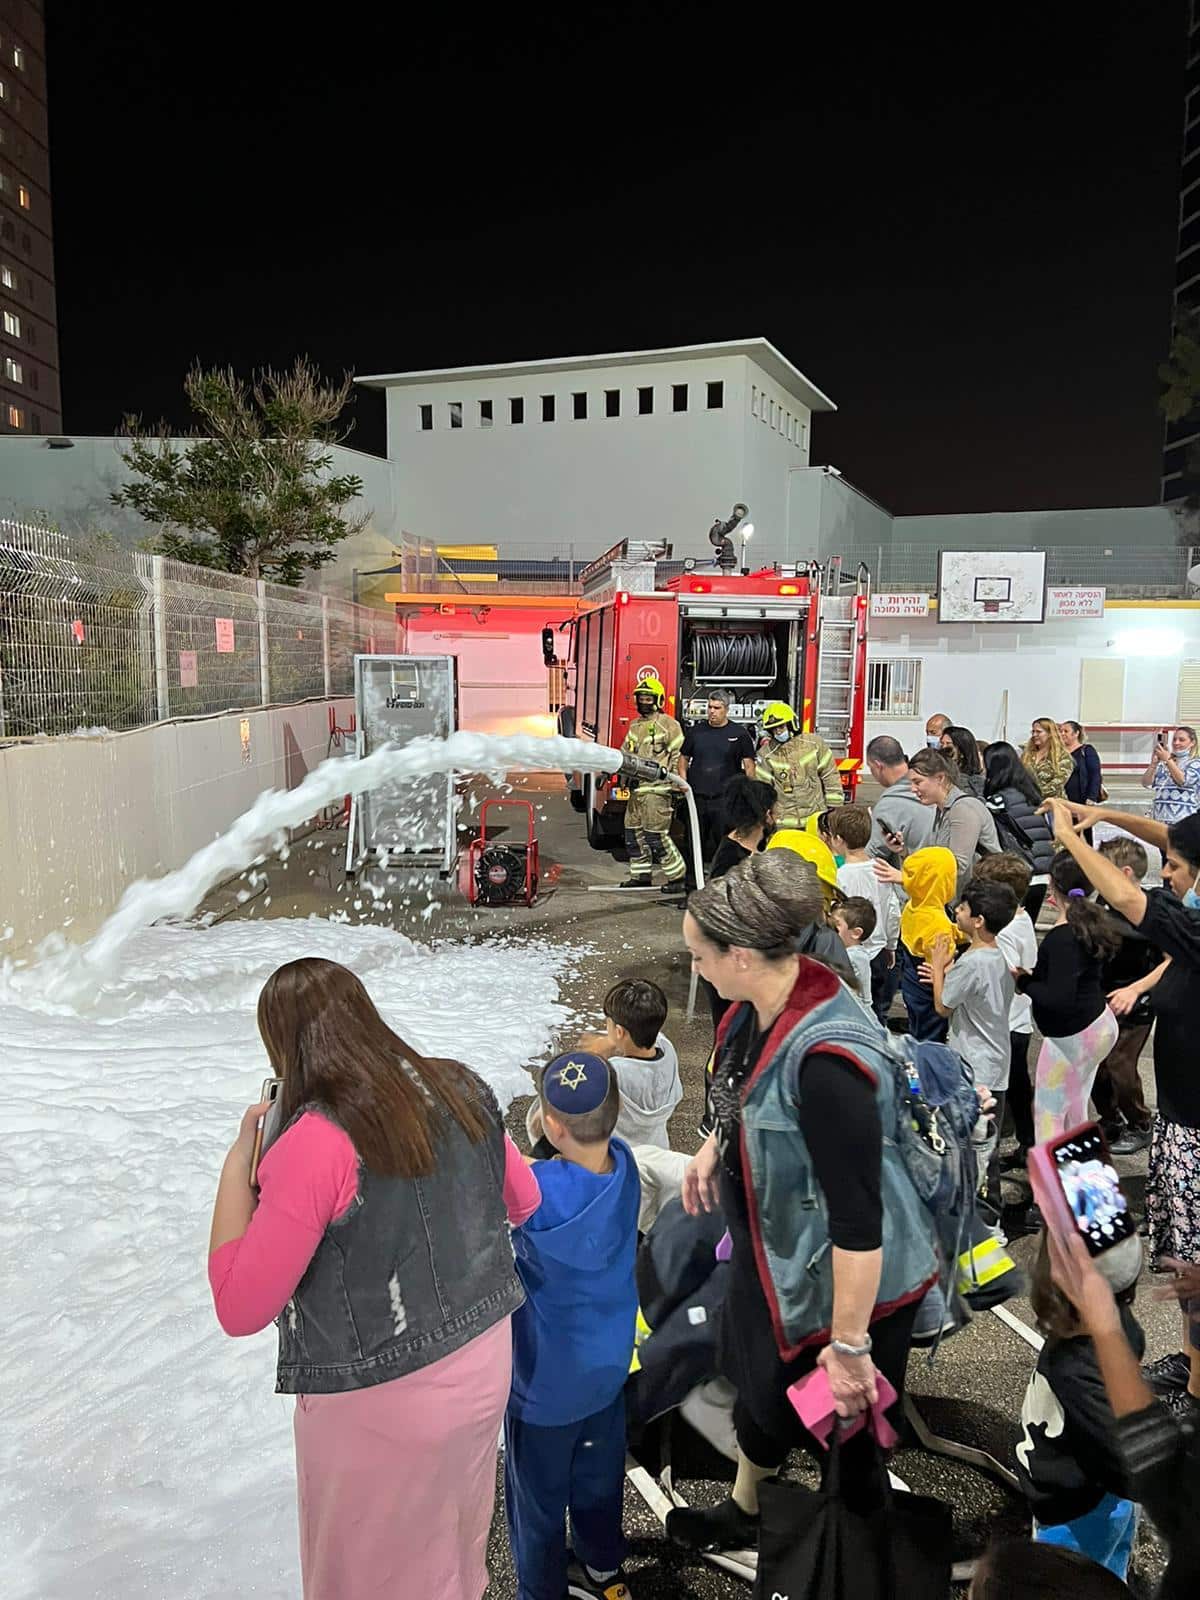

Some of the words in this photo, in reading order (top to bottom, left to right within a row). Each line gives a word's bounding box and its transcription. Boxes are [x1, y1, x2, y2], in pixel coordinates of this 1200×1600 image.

[904, 606, 925, 615] קורה
[638, 610, 661, 637] 10
[640, 671, 656, 680] 404
